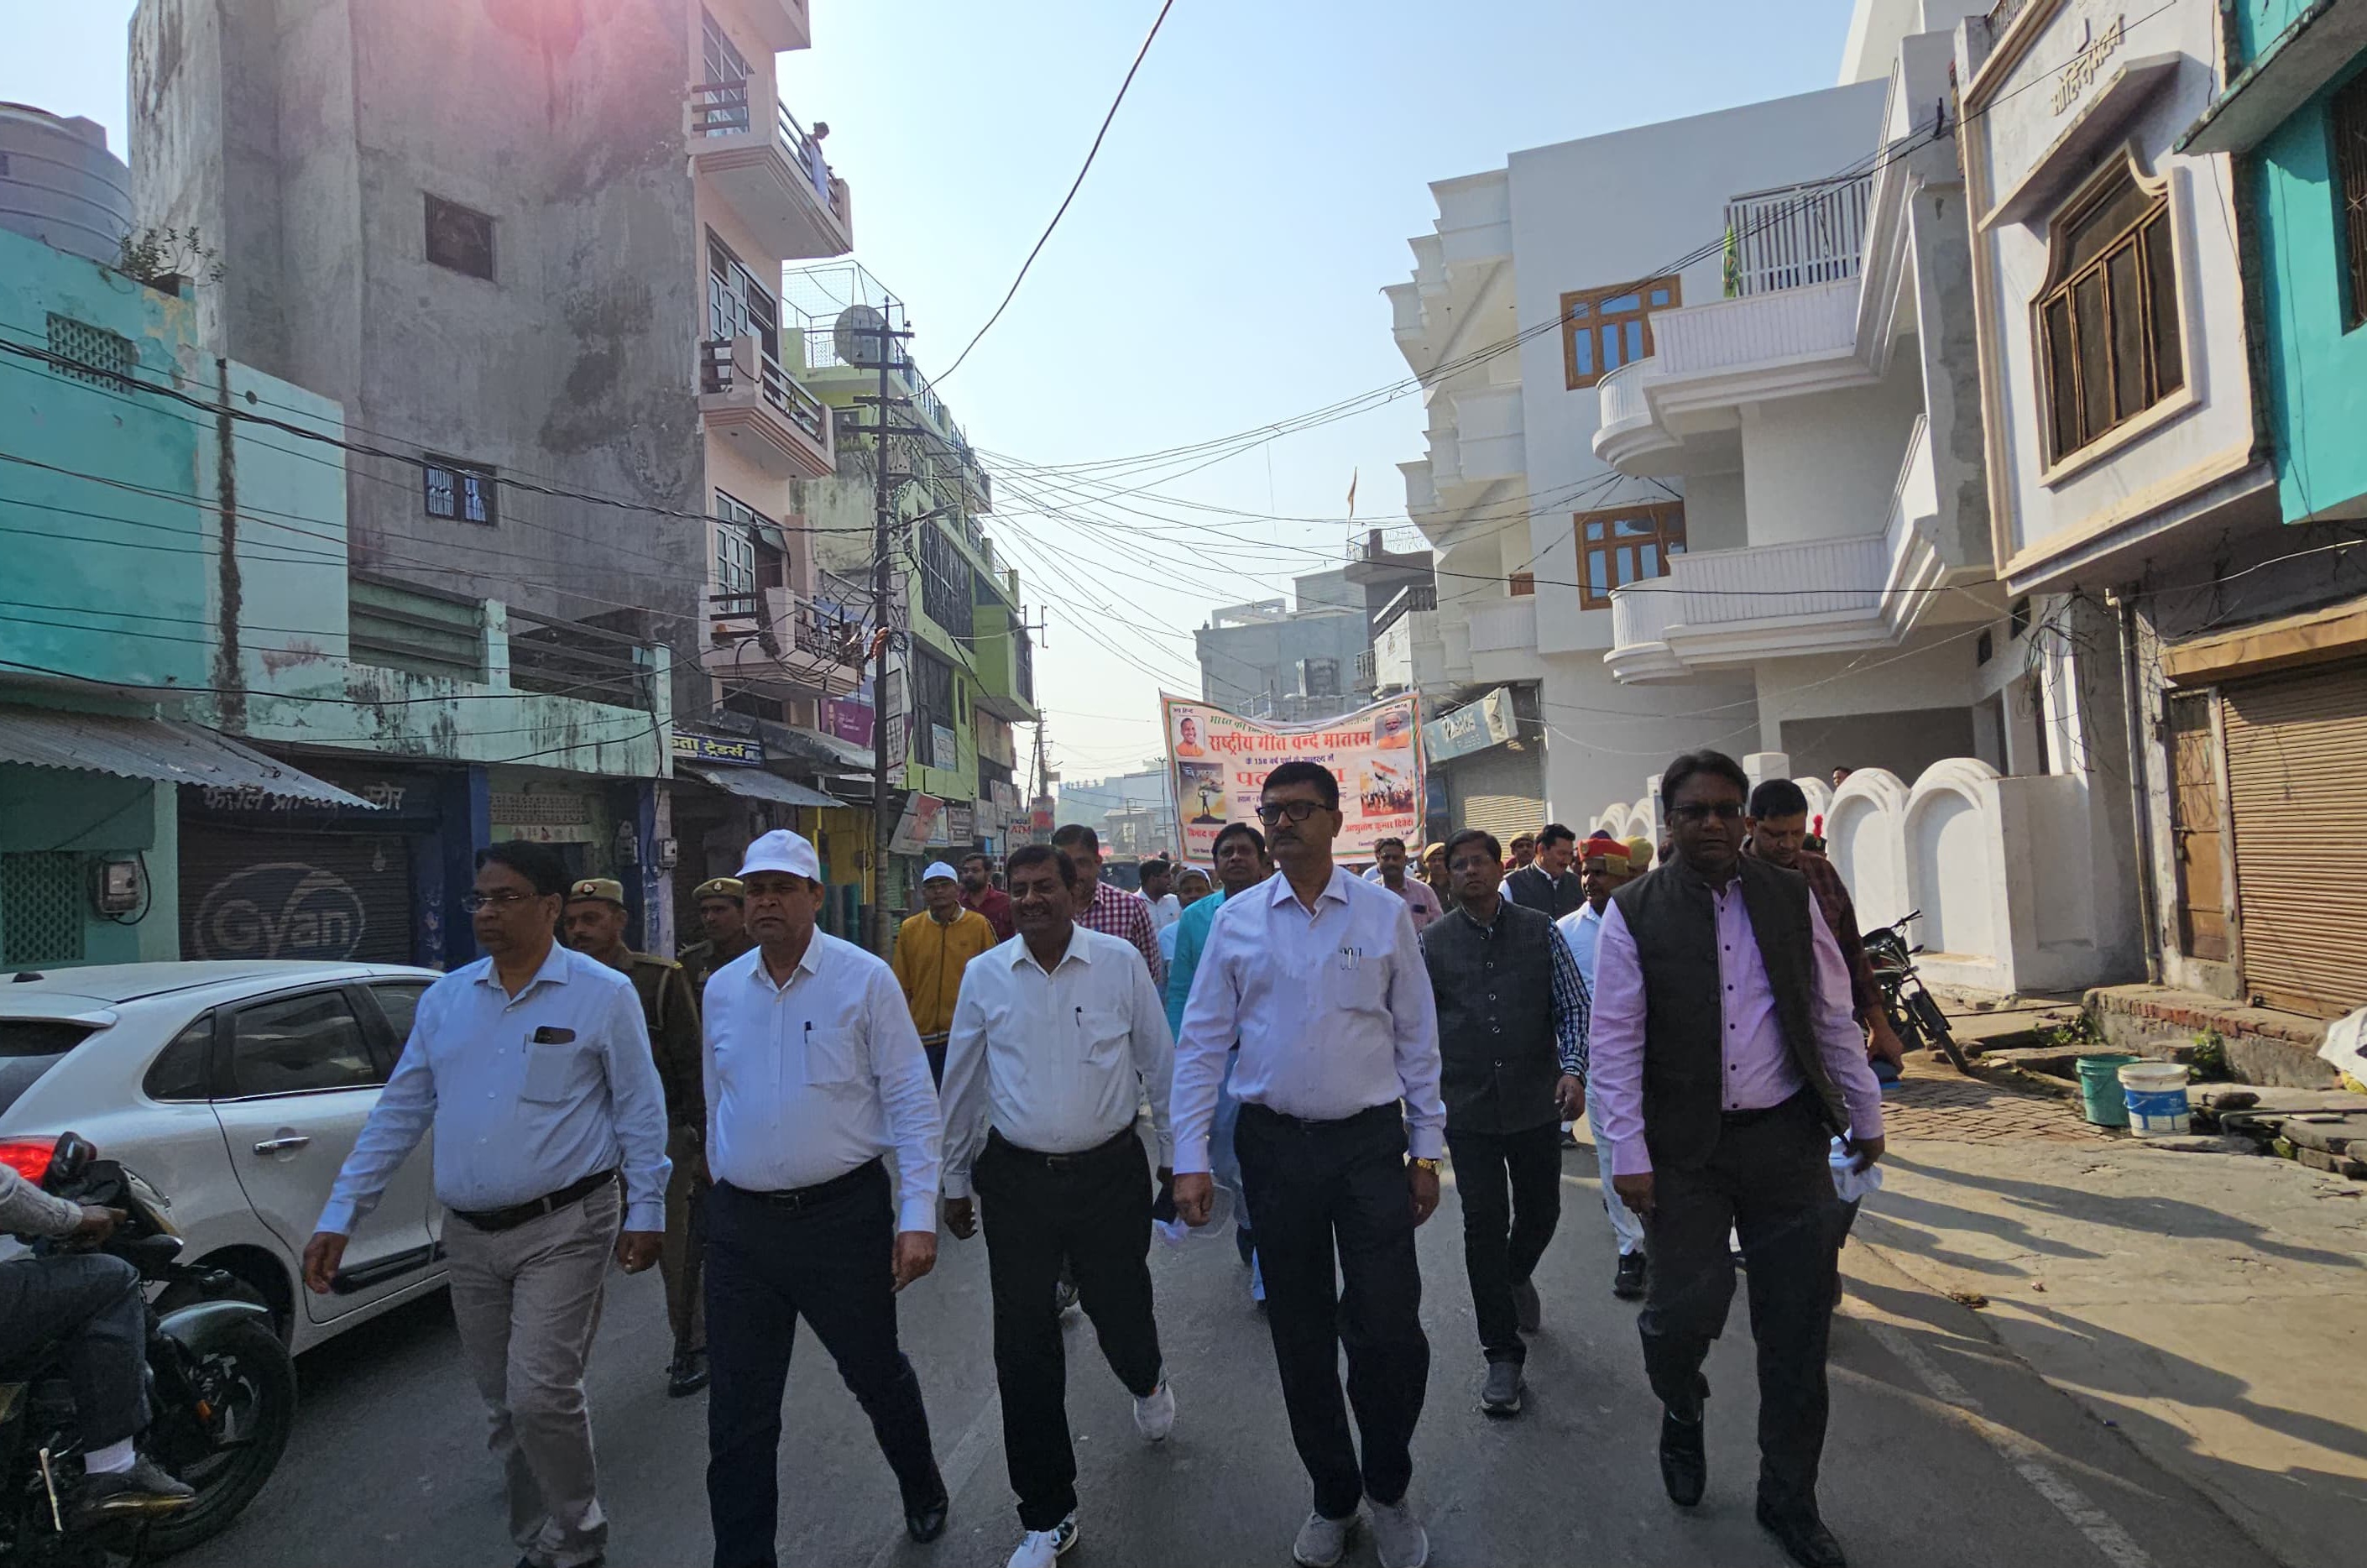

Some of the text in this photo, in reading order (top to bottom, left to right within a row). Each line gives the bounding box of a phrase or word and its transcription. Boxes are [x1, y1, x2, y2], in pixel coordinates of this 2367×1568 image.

[1208, 731, 1253, 755] राष्ट्रीय
[1257, 733, 1287, 751] गीत
[1292, 732, 1319, 750] वन्दे
[1323, 731, 1372, 749] मातरम
[1011, 825, 1032, 834] ATM
[212, 899, 352, 959] Gyan
